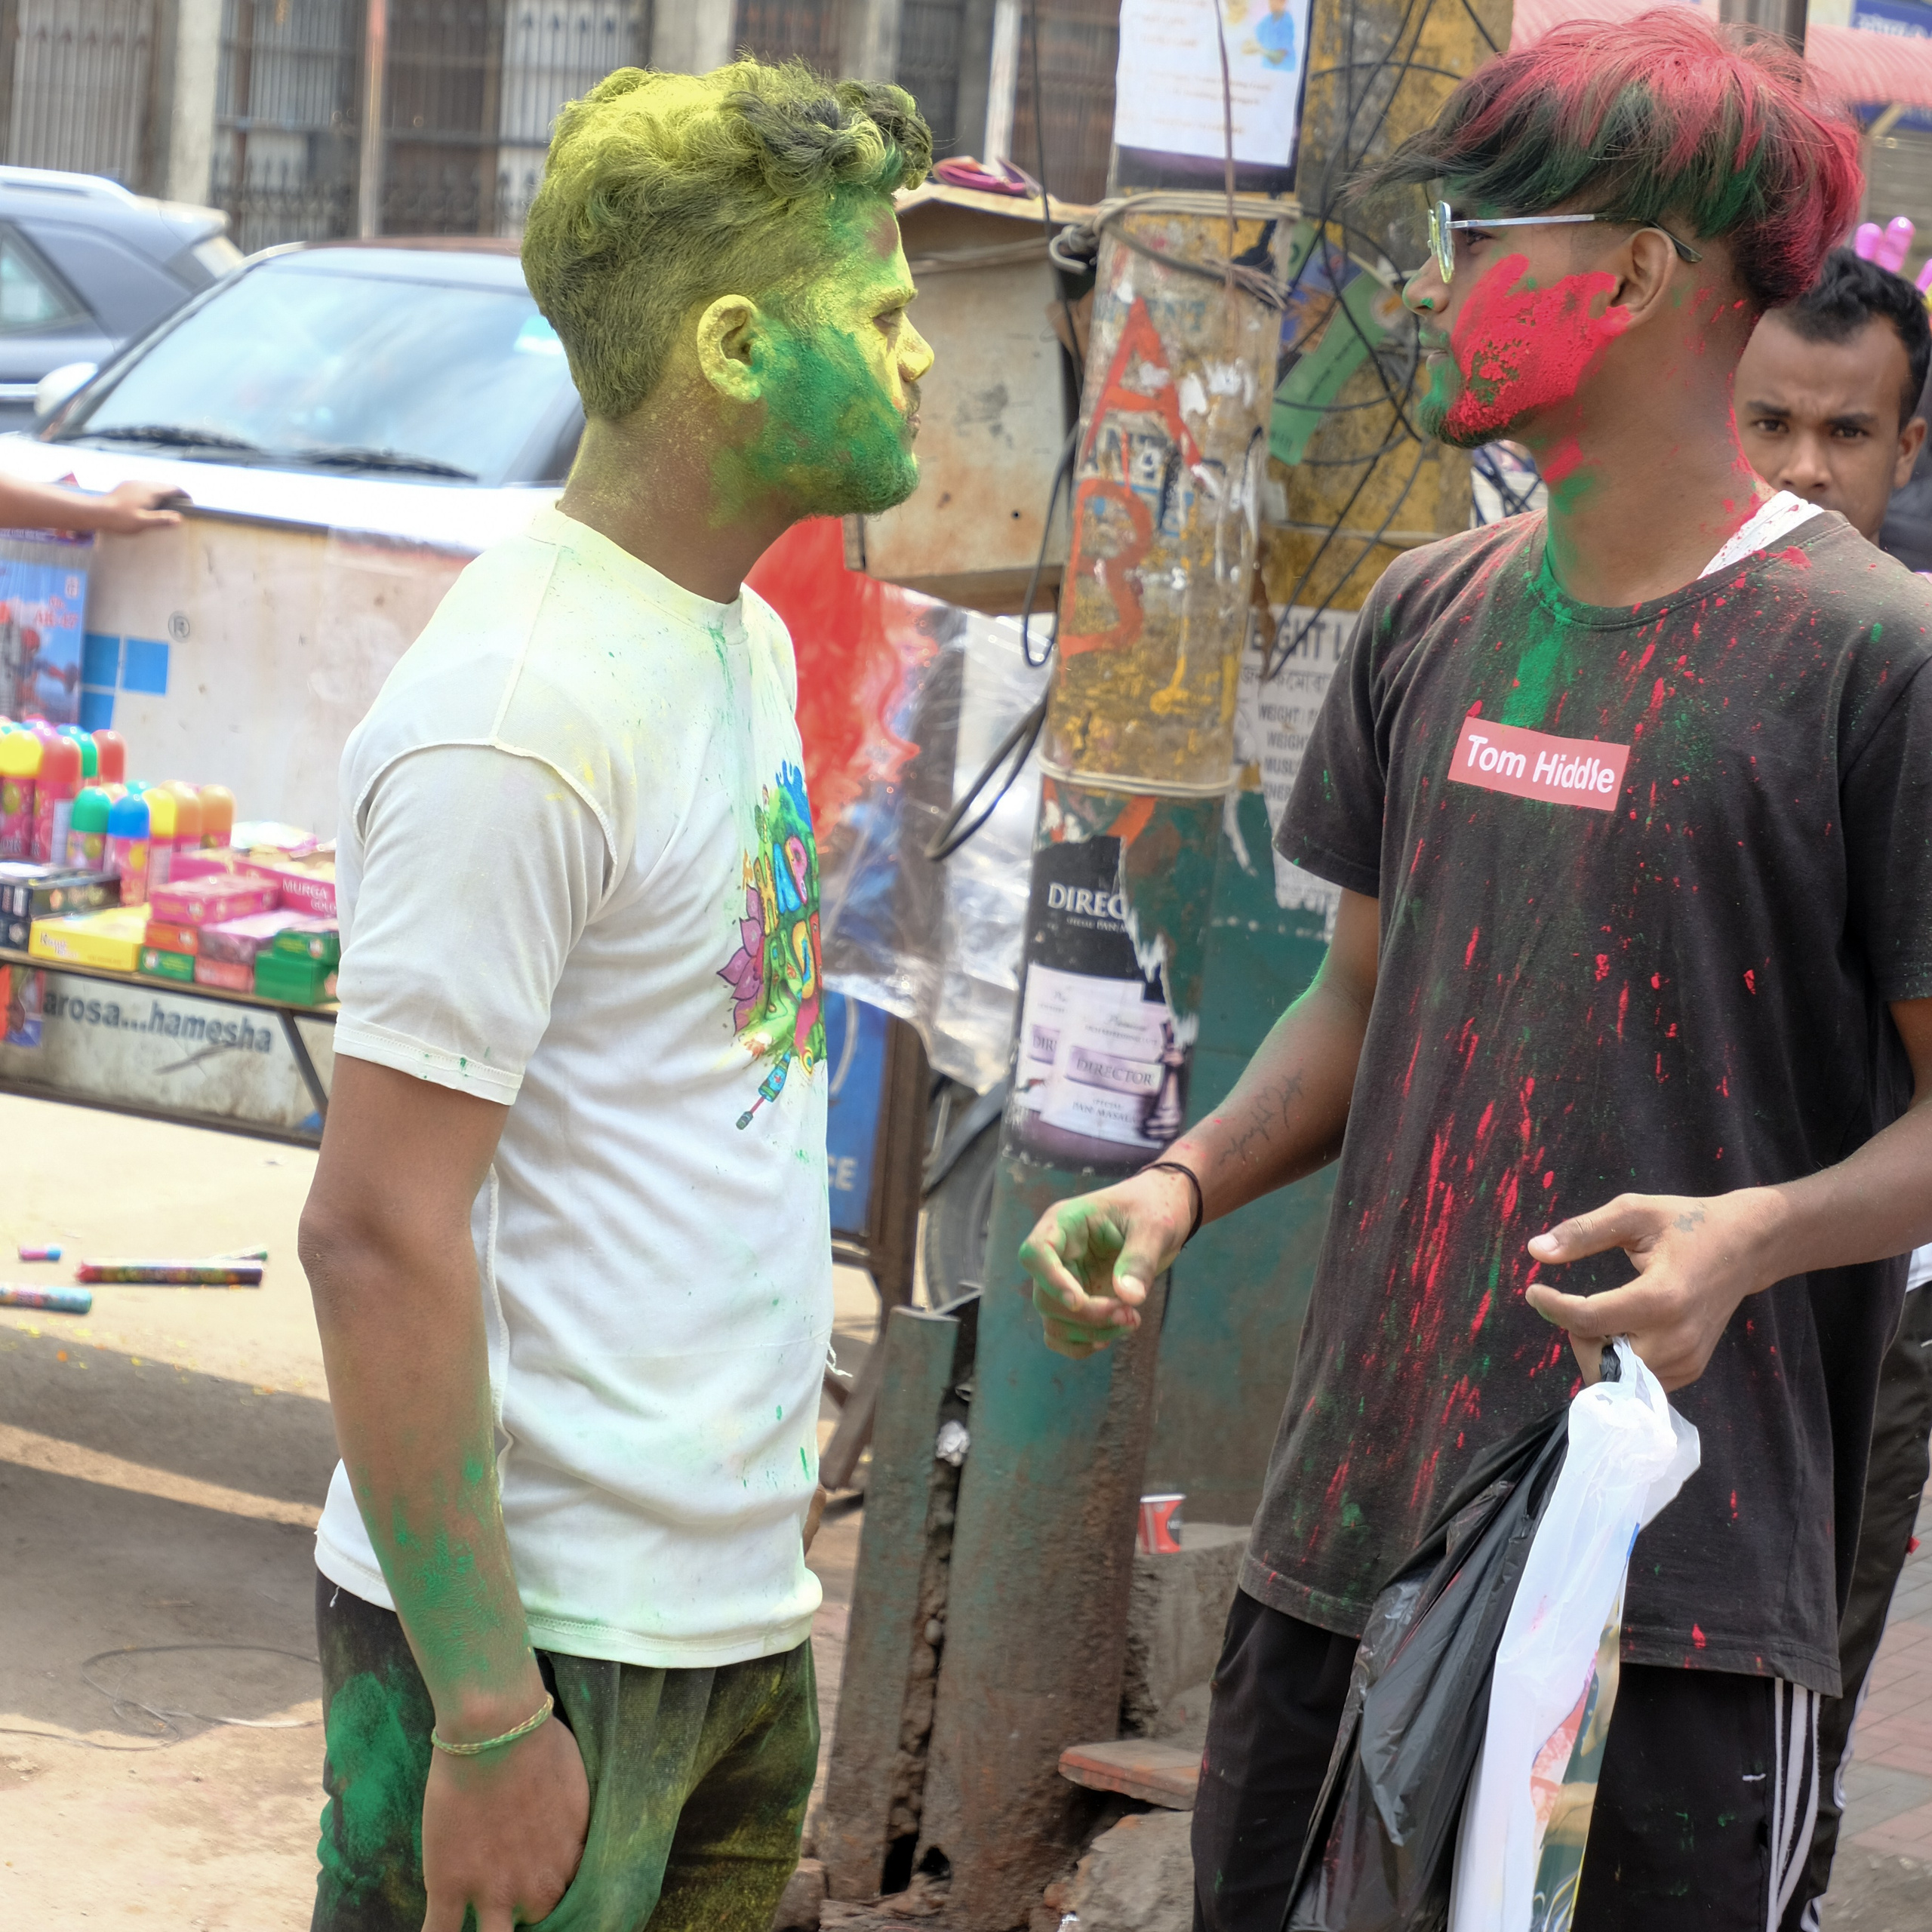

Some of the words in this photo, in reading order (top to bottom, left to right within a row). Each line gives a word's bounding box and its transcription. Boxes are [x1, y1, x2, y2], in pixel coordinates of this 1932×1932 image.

[1251, 614, 1326, 660] EGHT
[1468, 734, 1526, 778] Tom
[1533, 751, 1615, 793] Hiddle
[282, 877, 327, 900] MURGA
[1076, 1057, 1153, 1087] DIRECTOR
[1072, 1101, 1094, 1114] PAN
